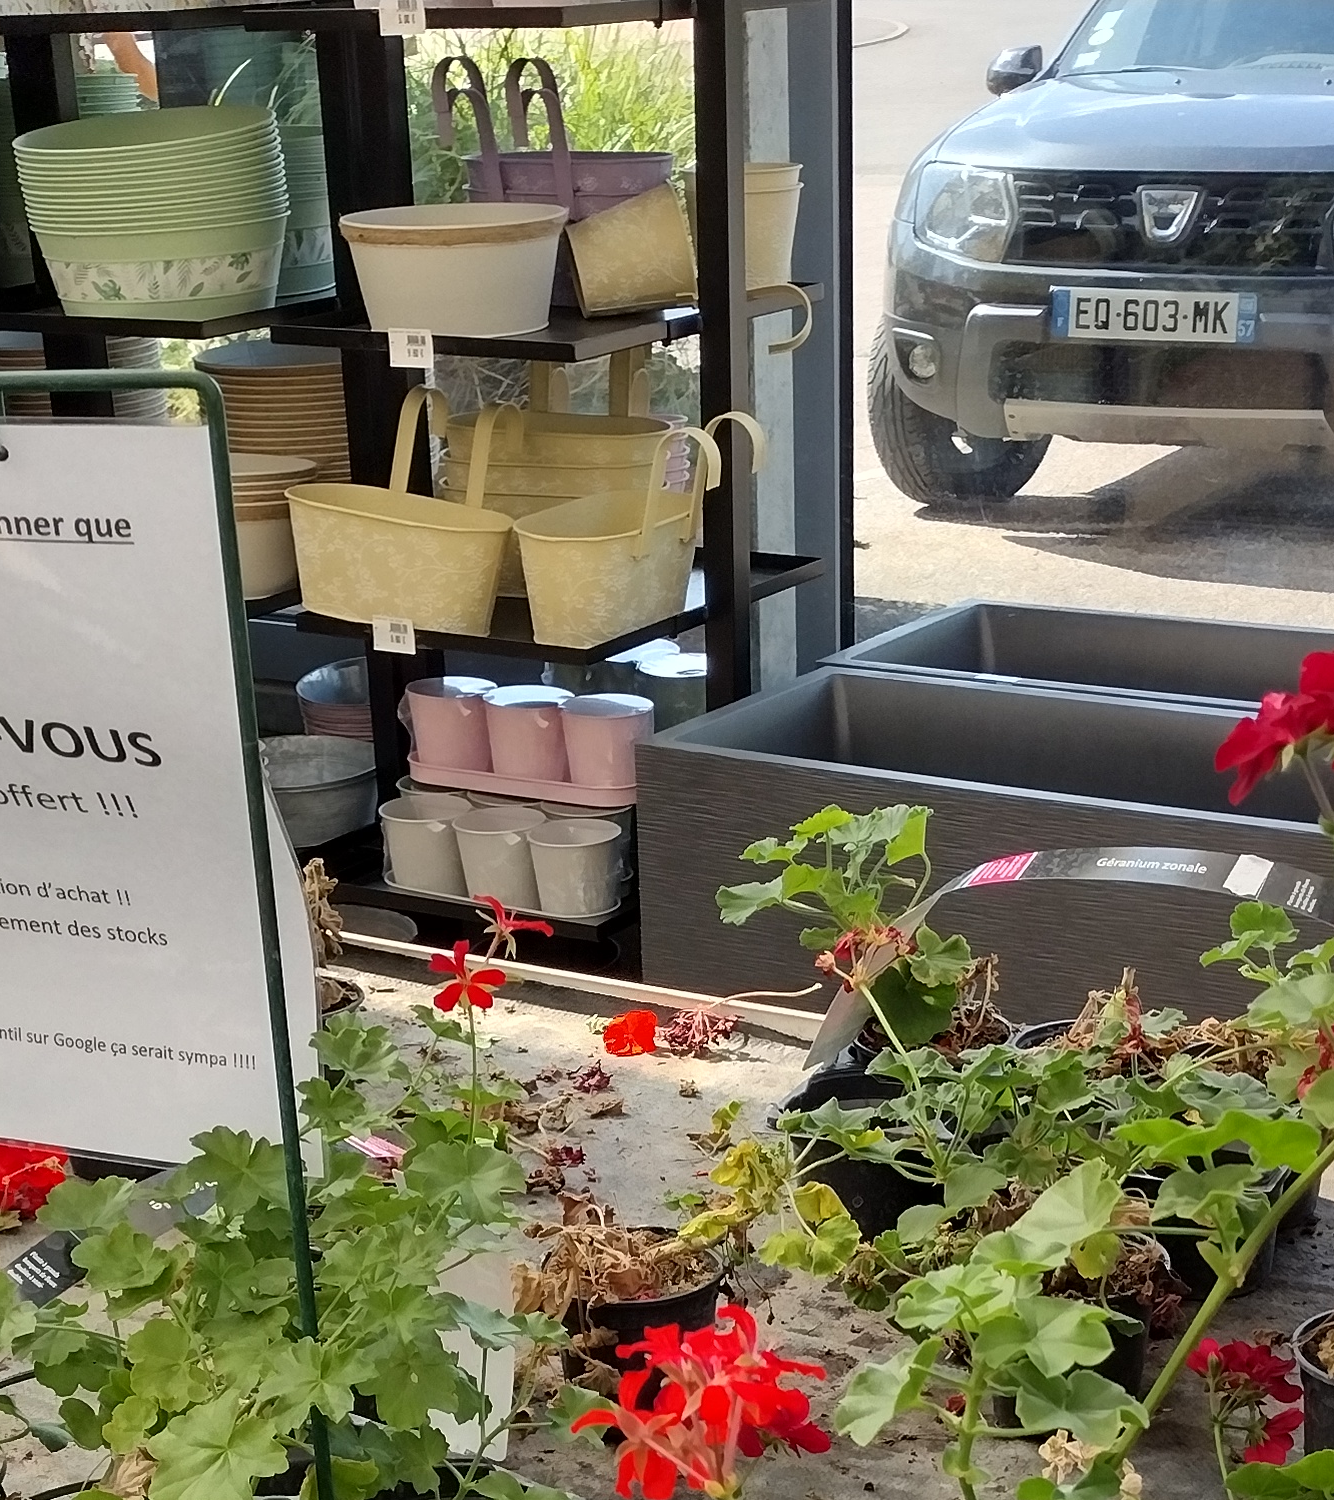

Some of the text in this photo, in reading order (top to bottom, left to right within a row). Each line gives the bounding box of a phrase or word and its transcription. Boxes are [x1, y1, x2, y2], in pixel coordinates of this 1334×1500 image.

[1237, 319, 1255, 337] 57
[75, 514, 132, 544] que
[96, 791, 139, 819] !!!
[1096, 857, 1208, 874] Géranium zonale
[36, 881, 111, 905] d'achat
[116, 888, 131, 907] !!
[67, 919, 102, 939] des
[106, 925, 168, 946] stocks
[26, 1032, 50, 1046] sur
[53, 1032, 107, 1054] Google
[110, 1042, 127, 1057] ça
[131, 1044, 174, 1061] serait
[178, 1050, 227, 1069] sympa
[233, 1052, 256, 1071] !!!!
